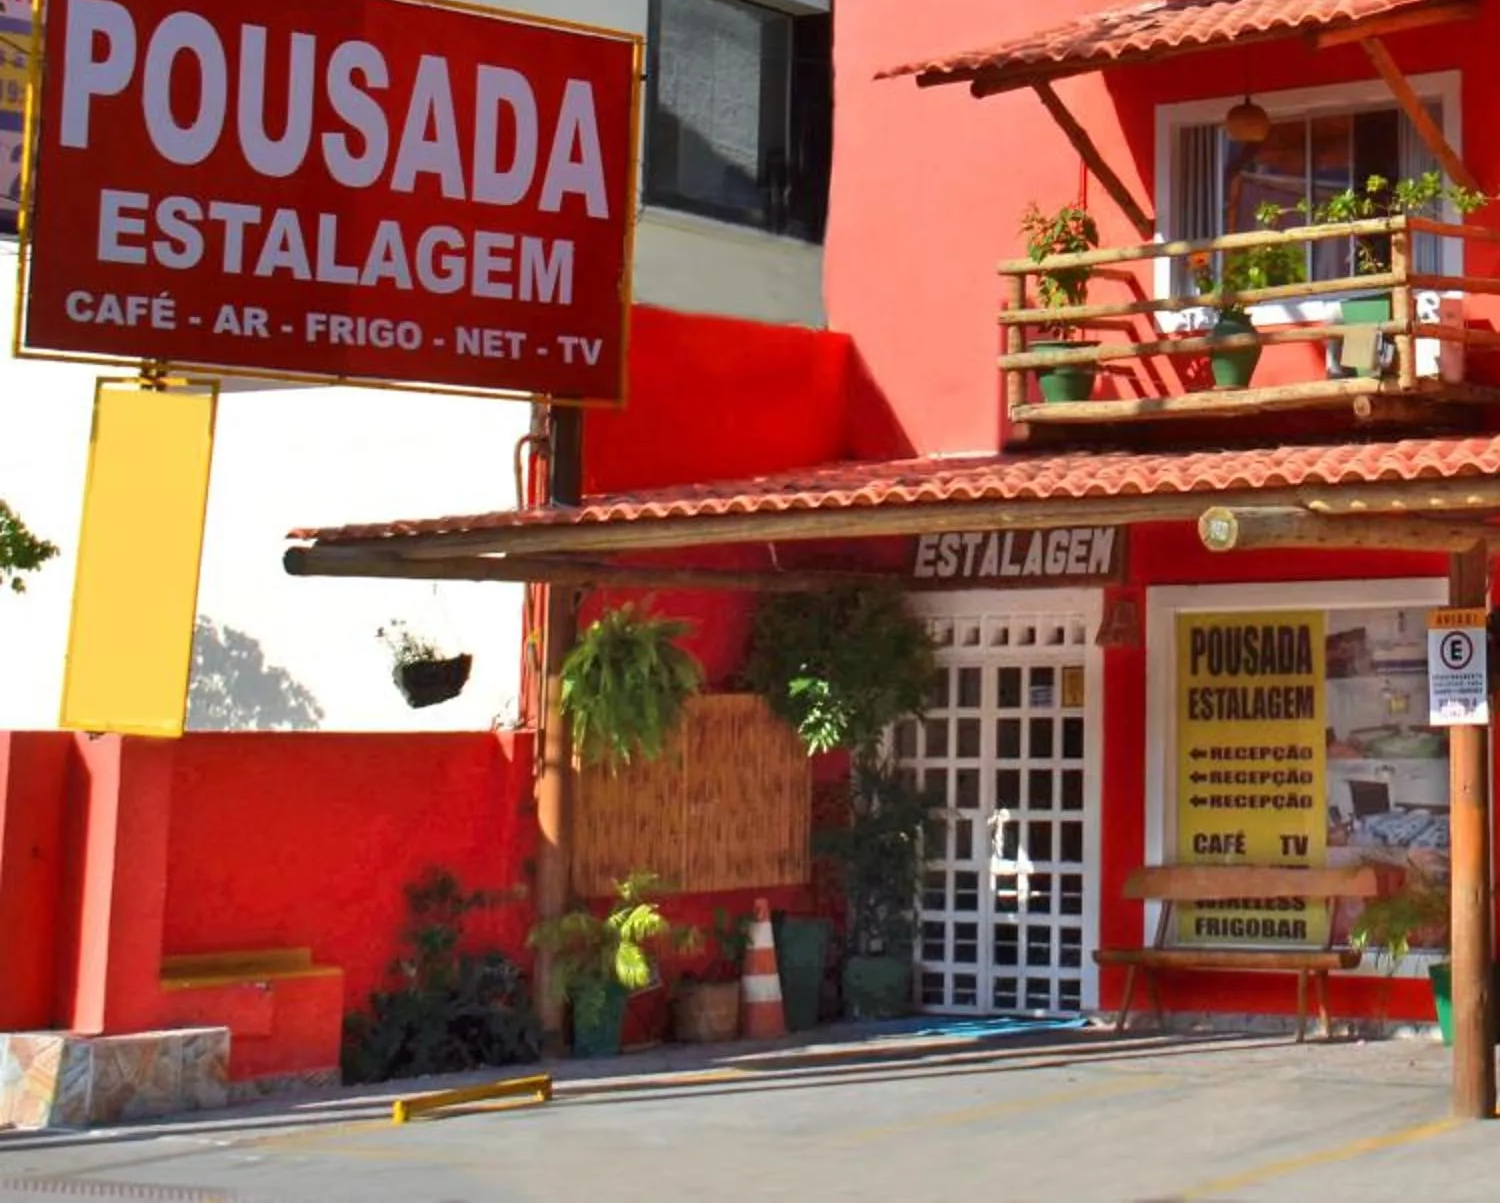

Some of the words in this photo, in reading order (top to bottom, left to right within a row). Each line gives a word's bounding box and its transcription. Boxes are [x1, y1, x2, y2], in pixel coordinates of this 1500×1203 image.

[97, 188, 575, 305] ESTALAGEM
[65, 290, 176, 330] CAFÉ
[213, 304, 270, 338] AR
[305, 311, 423, 351] FRIGO
[455, 328, 528, 360] NET
[557, 335, 603, 366] TV
[913, 527, 1116, 578] ESTALAGEM
[1190, 624, 1313, 676] POUSADA
[1451, 640, 1463, 661] E
[1188, 685, 1315, 721] ESTALAGEM
[1210, 744, 1313, 762] RECEPÇÃO
[1210, 768, 1313, 786] RECEPÇÃO
[1210, 792, 1313, 810] RECEPÇÃO
[1193, 829, 1247, 855] CAFÉ
[1280, 834, 1309, 856] TV
[1194, 916, 1307, 940] FRIGOBAR
